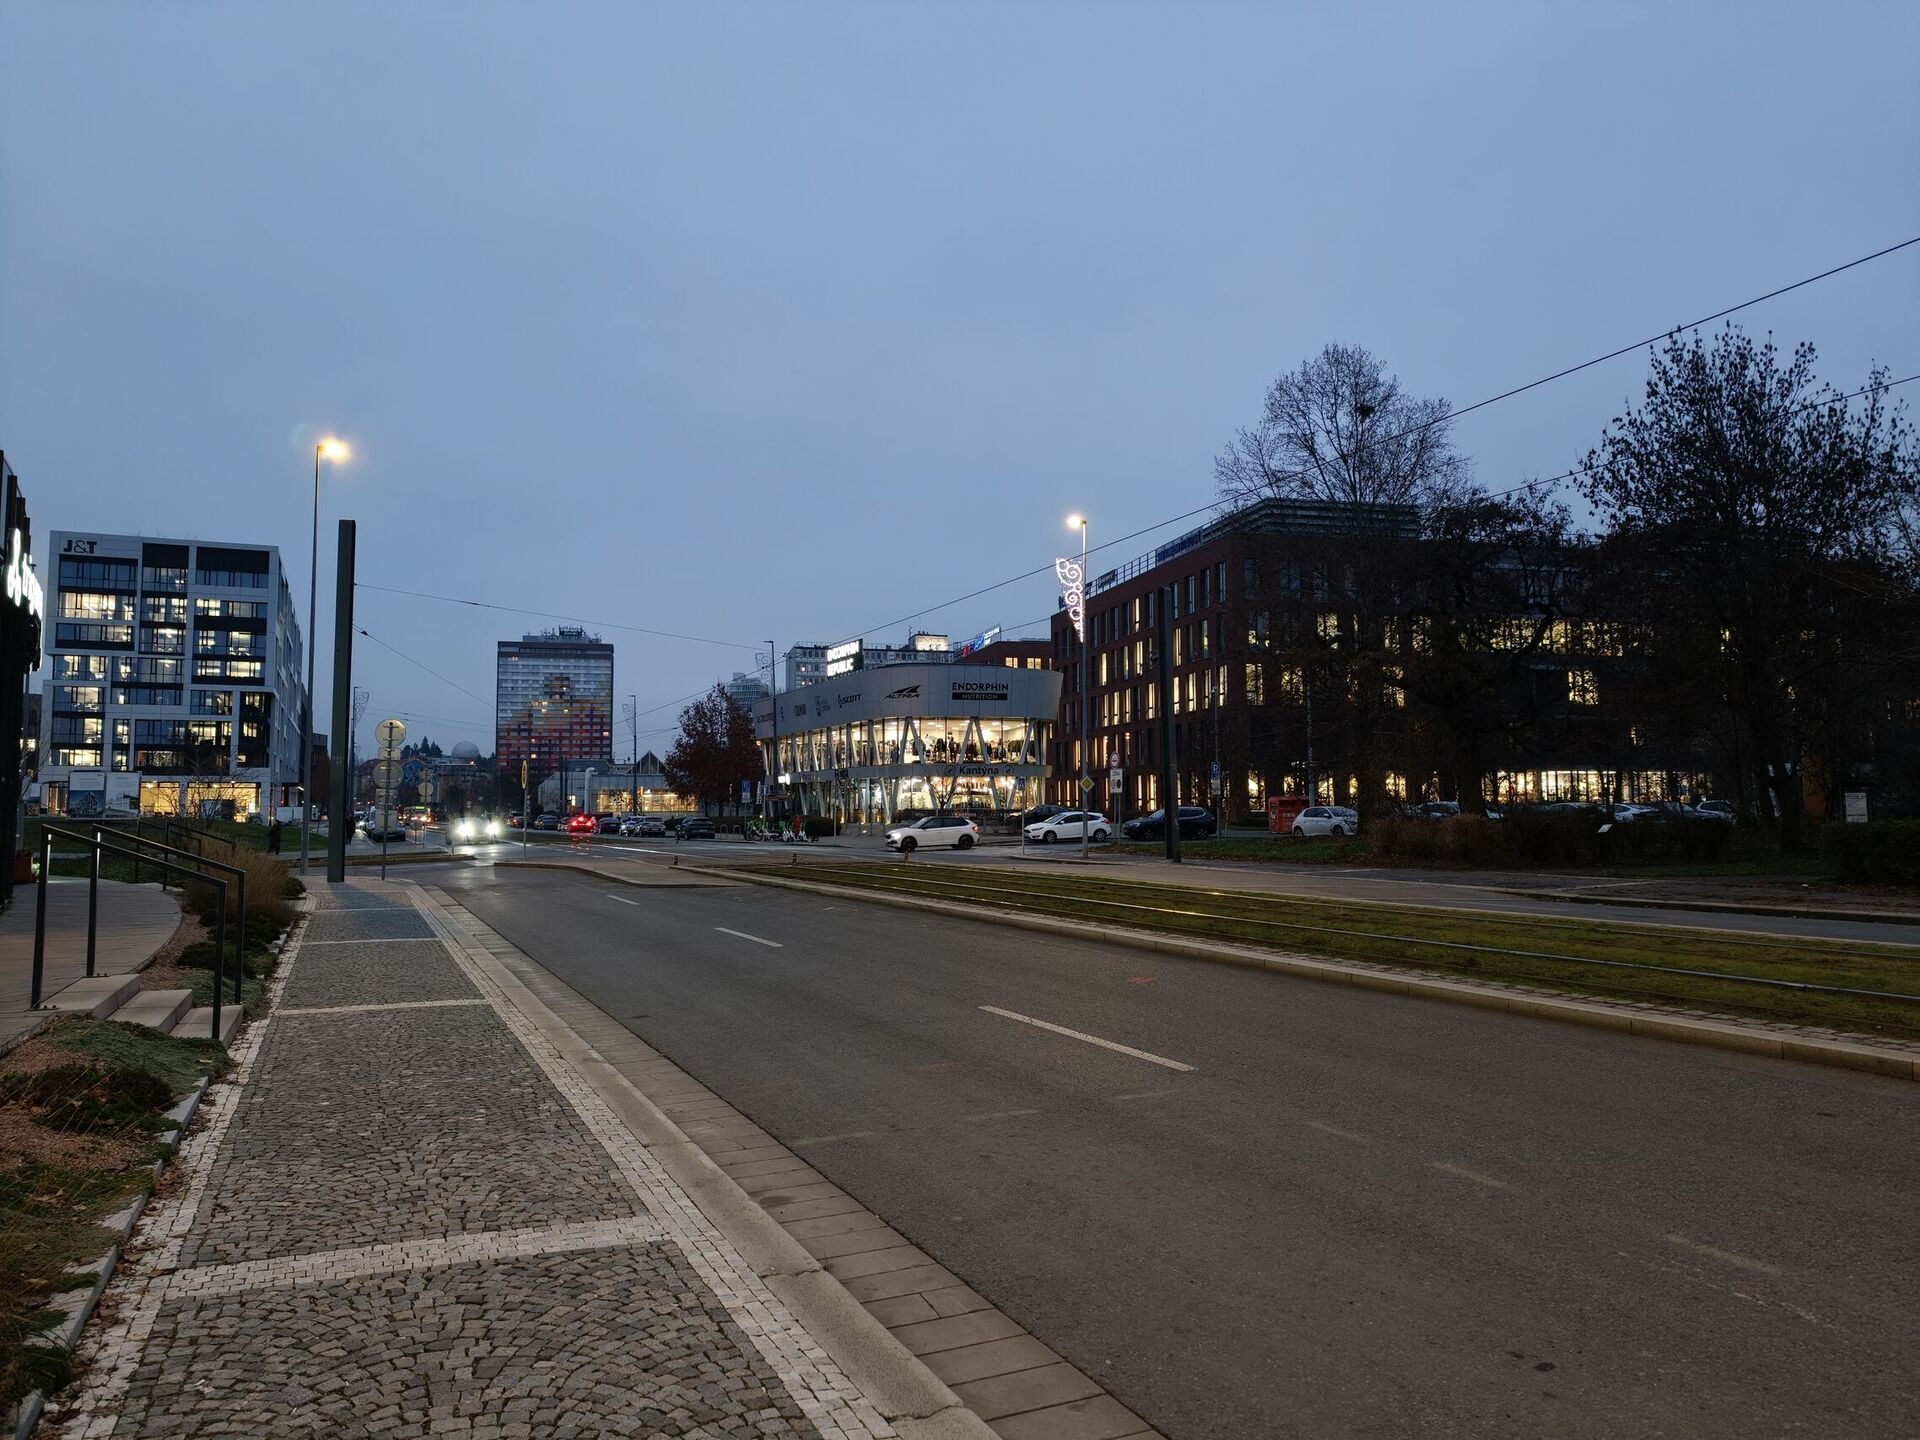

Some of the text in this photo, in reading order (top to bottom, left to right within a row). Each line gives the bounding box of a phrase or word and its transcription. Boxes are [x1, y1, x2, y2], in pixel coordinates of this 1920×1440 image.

[63, 539, 98, 554] J&T
[952, 682, 1009, 692] ENDORPHIN
[842, 693, 862, 704] SCOTT
[959, 766, 999, 776] Kantýna
